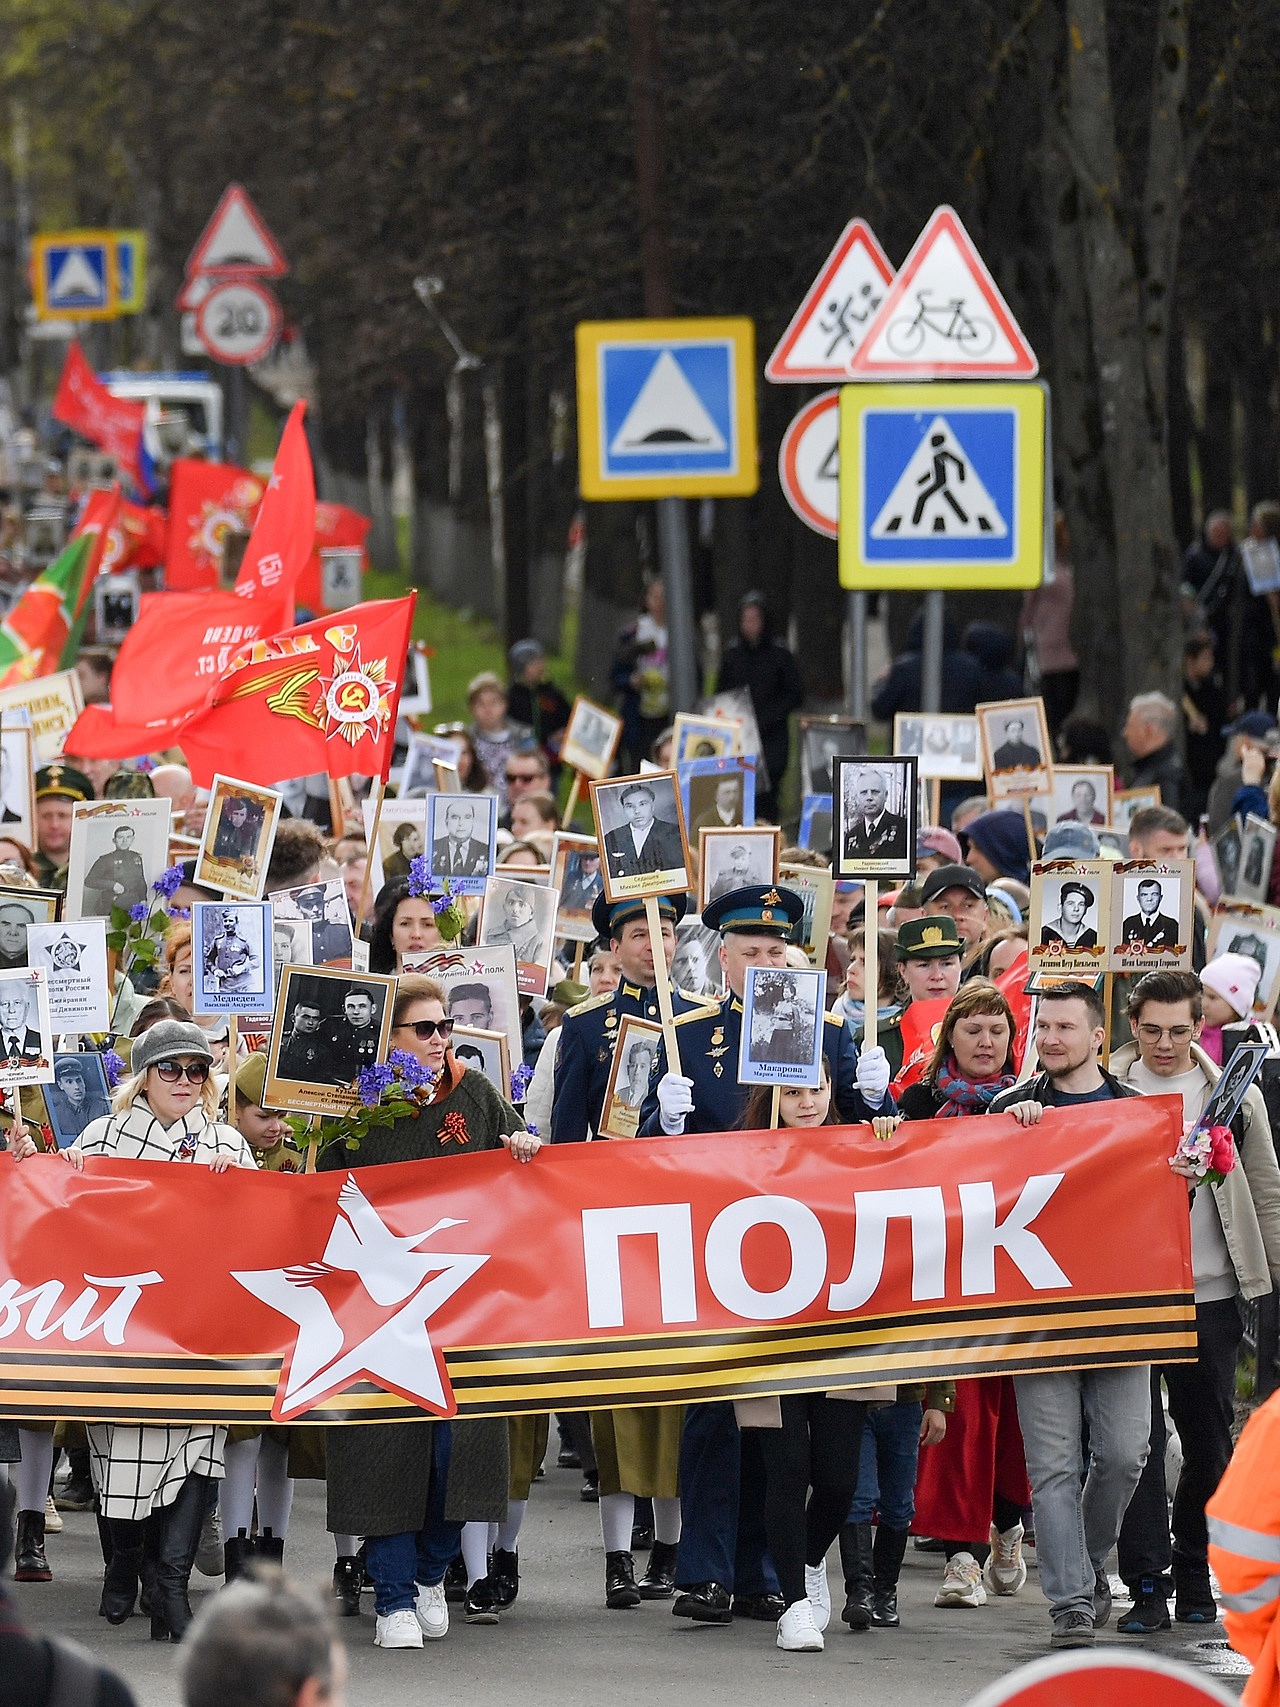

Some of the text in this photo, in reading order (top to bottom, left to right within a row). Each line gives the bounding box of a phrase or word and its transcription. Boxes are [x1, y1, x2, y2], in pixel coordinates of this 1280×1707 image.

[219, 307, 258, 336] 20
[484, 966, 505, 974] ПОЛК
[47, 977, 92, 986] ессмертный
[213, 995, 256, 1003] Медведев
[758, 1063, 803, 1073] Макарова
[287, 1098, 336, 1110] БЕССМЕРТНЫЙ
[581, 1172, 1073, 1329] ПОЛК
